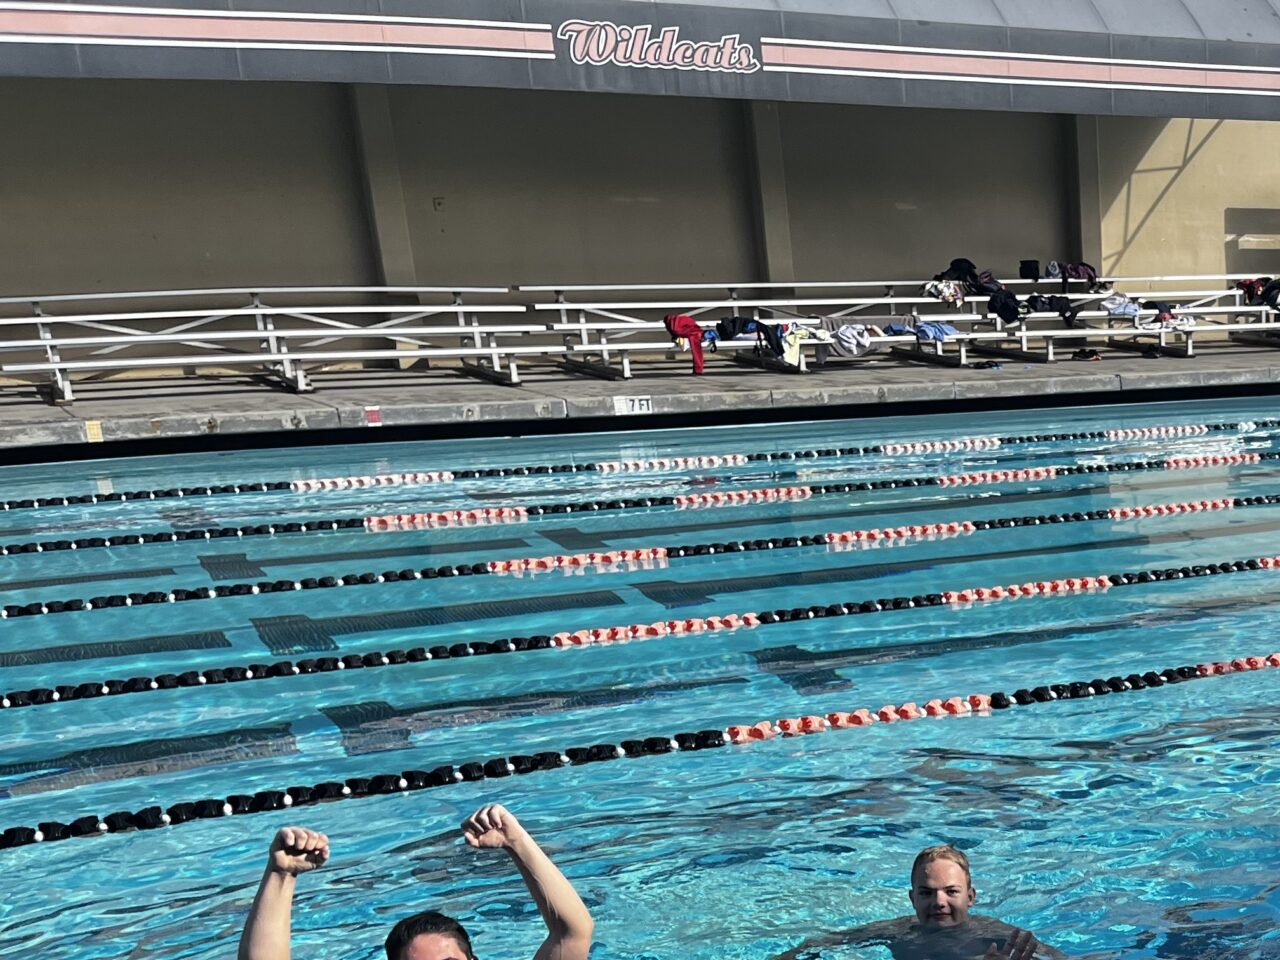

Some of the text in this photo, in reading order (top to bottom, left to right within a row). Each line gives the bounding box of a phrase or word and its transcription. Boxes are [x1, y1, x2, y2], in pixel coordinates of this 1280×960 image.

[557, 20, 760, 74] Wildcats
[629, 399, 650, 411] 7 FT
